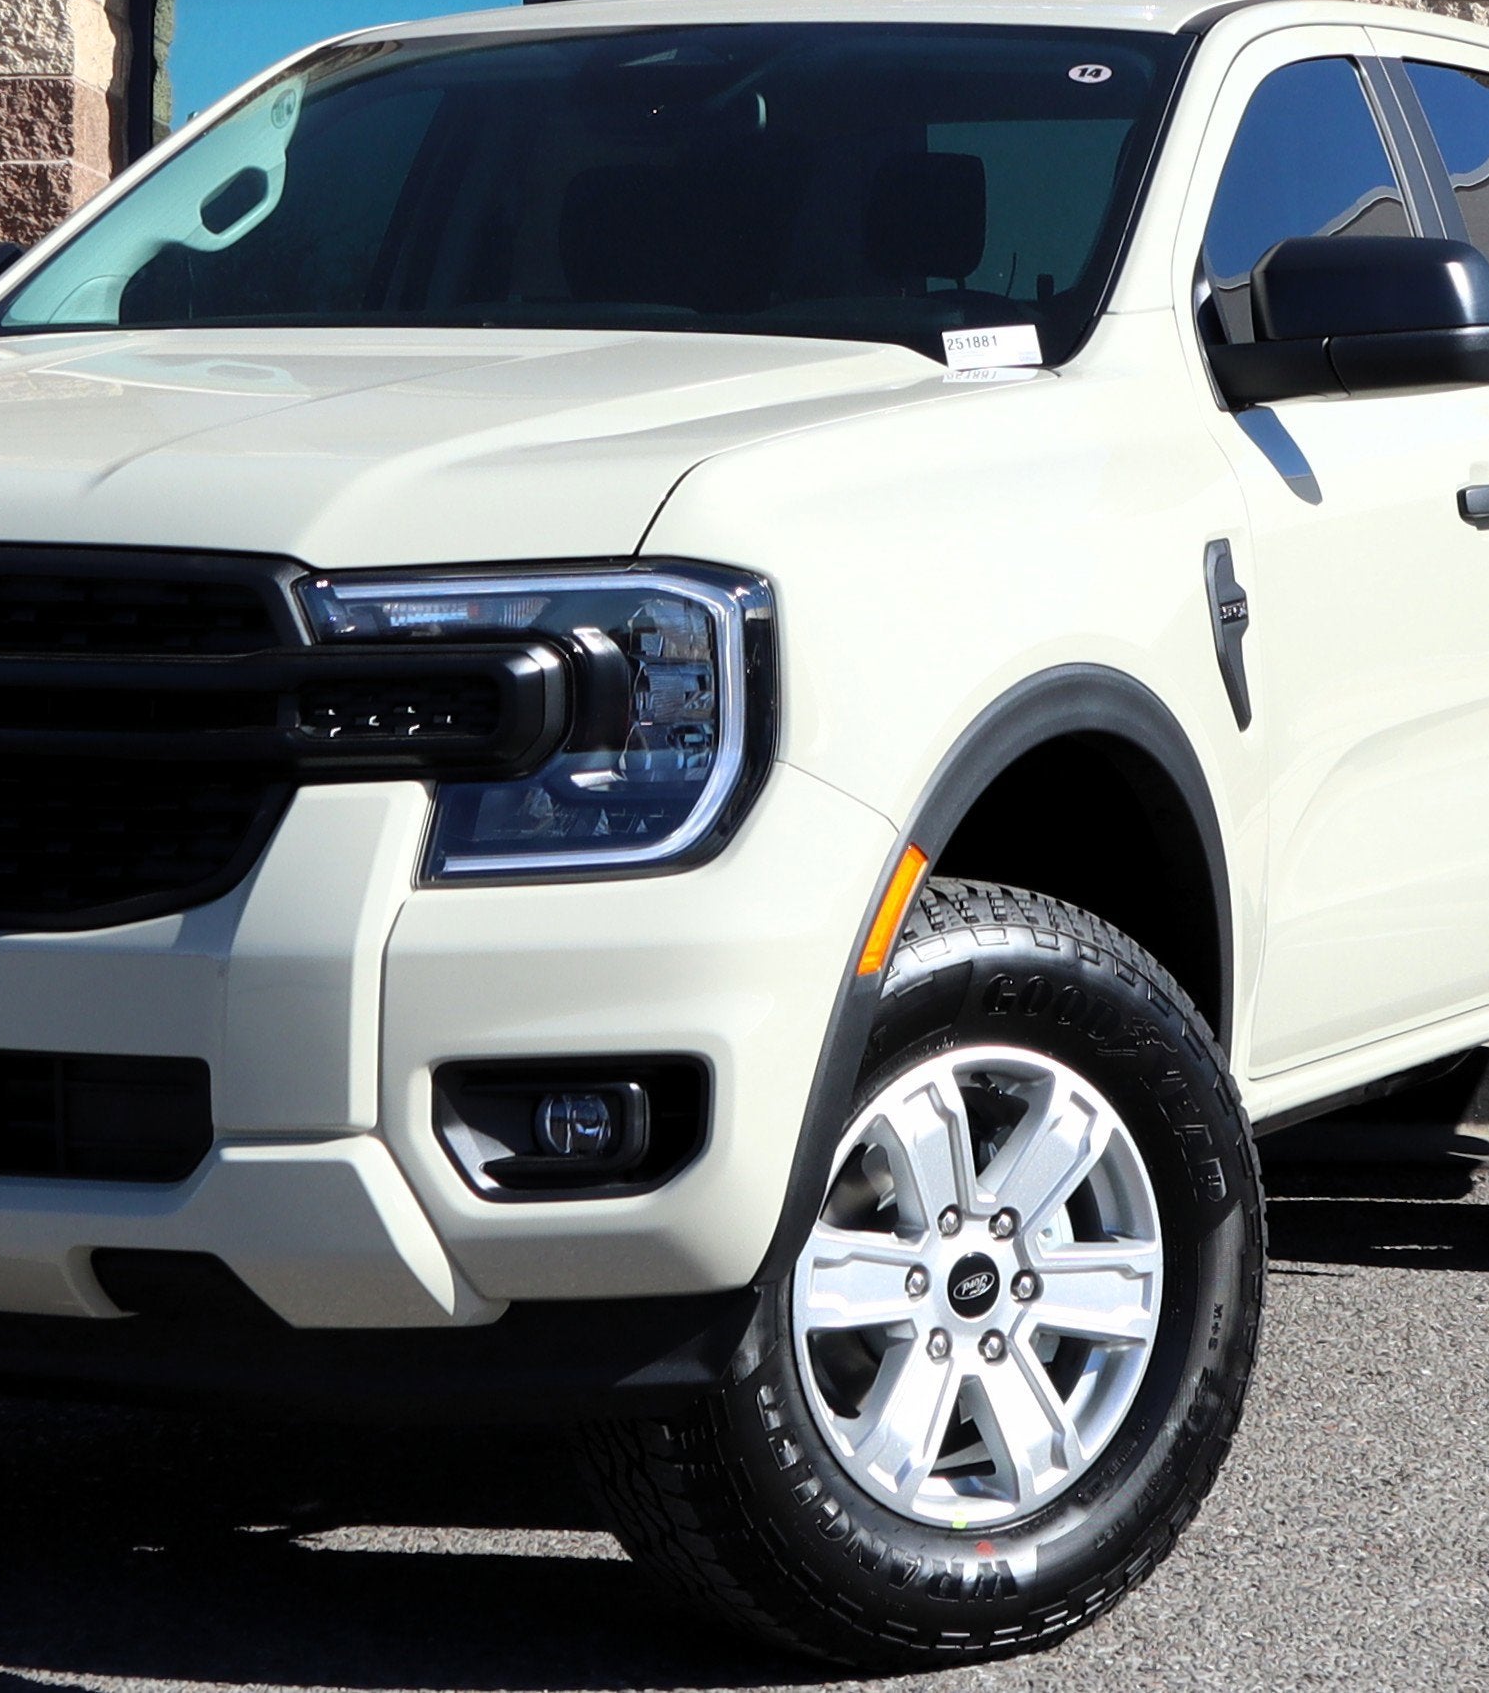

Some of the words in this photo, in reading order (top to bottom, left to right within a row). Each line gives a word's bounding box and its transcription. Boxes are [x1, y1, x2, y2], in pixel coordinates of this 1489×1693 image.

[1077, 67, 1103, 79] 14
[946, 334, 998, 351] 251881
[961, 1274, 989, 1296] Ford
[756, 1384, 1019, 1603] WRANGLER
